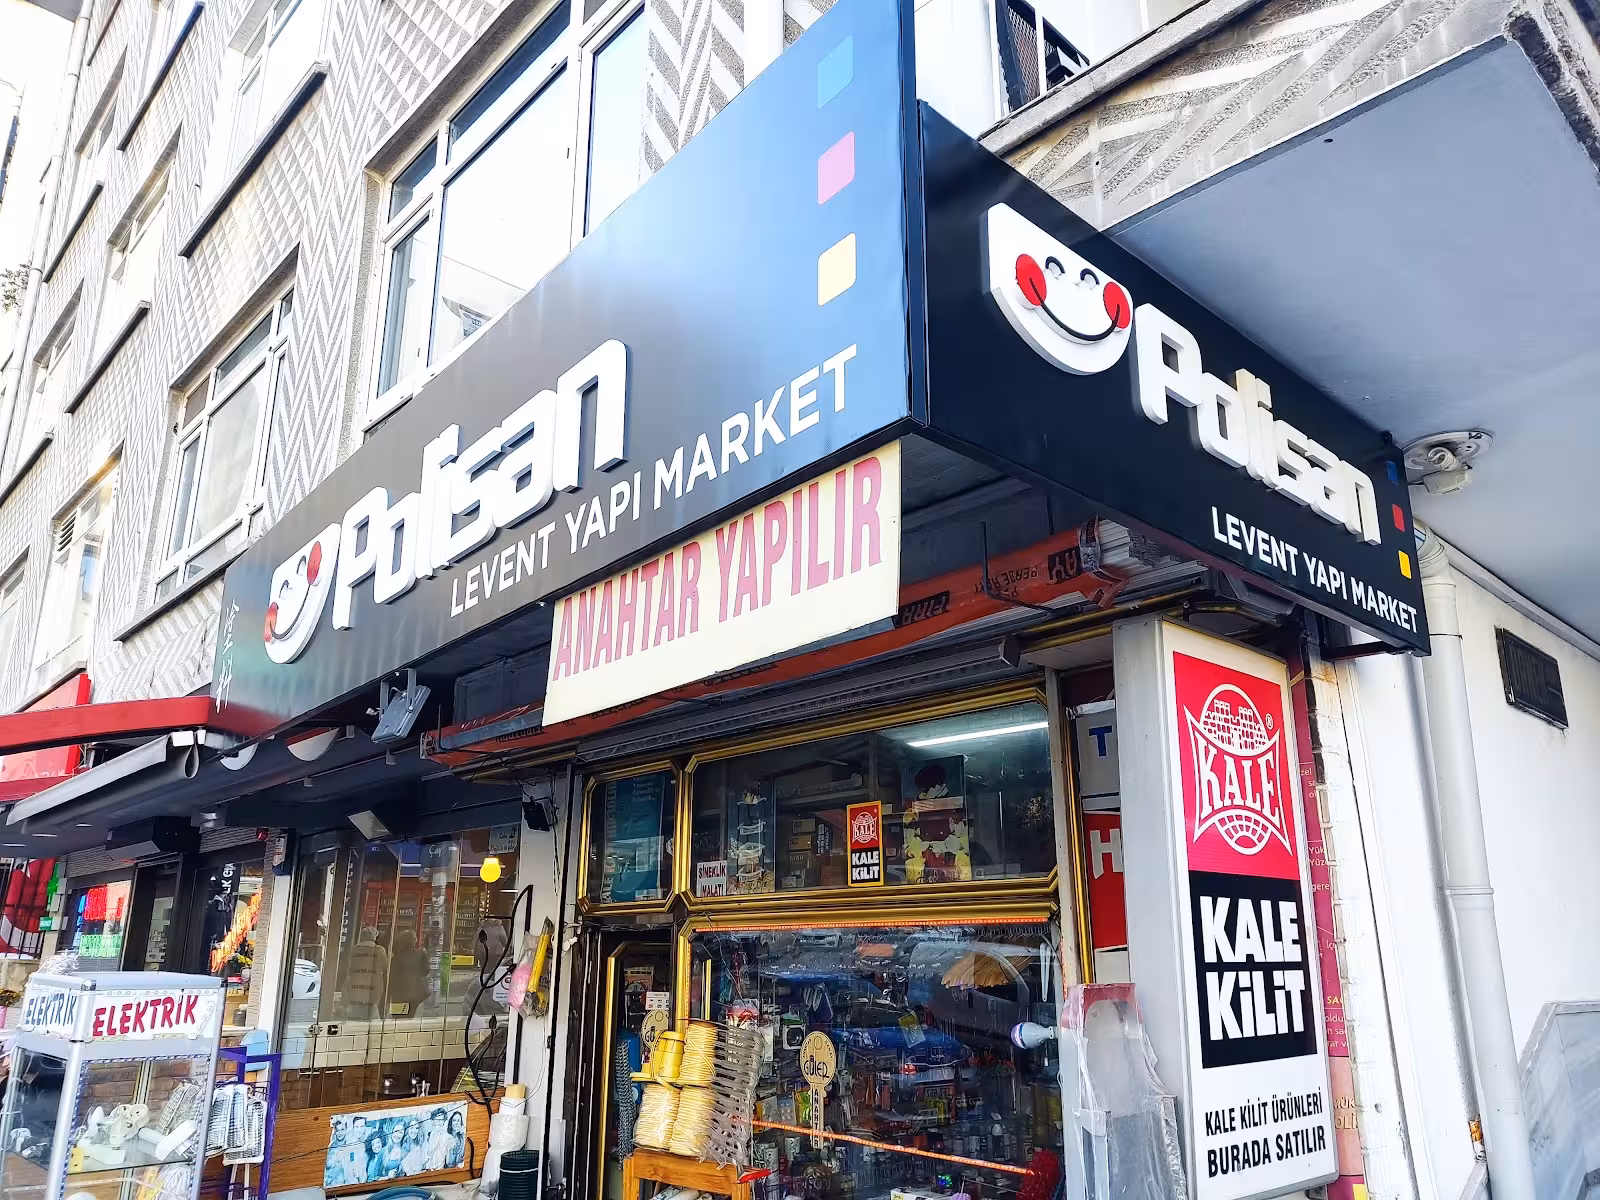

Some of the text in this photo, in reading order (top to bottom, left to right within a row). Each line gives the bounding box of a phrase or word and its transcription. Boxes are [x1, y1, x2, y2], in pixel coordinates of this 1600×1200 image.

[1135, 303, 1381, 545] Polisan
[332, 338, 628, 631] Polisan
[450, 343, 857, 619] LEVENT YAPI MARKET
[553, 456, 883, 682] ANAHTAR YAPILIR
[900, 596, 947, 626] FIRA
[1211, 506, 1418, 634] LEVENT YAPI MARKET
[1195, 730, 1281, 829] KALE
[852, 851, 879, 866] KALE
[854, 823, 874, 838] KALE
[1200, 895, 1302, 964] KALE
[1205, 1087, 1323, 1137] KALE KİLİT ÜRÜNLERİ
[1207, 1125, 1327, 1178] BURADA SATILIR
